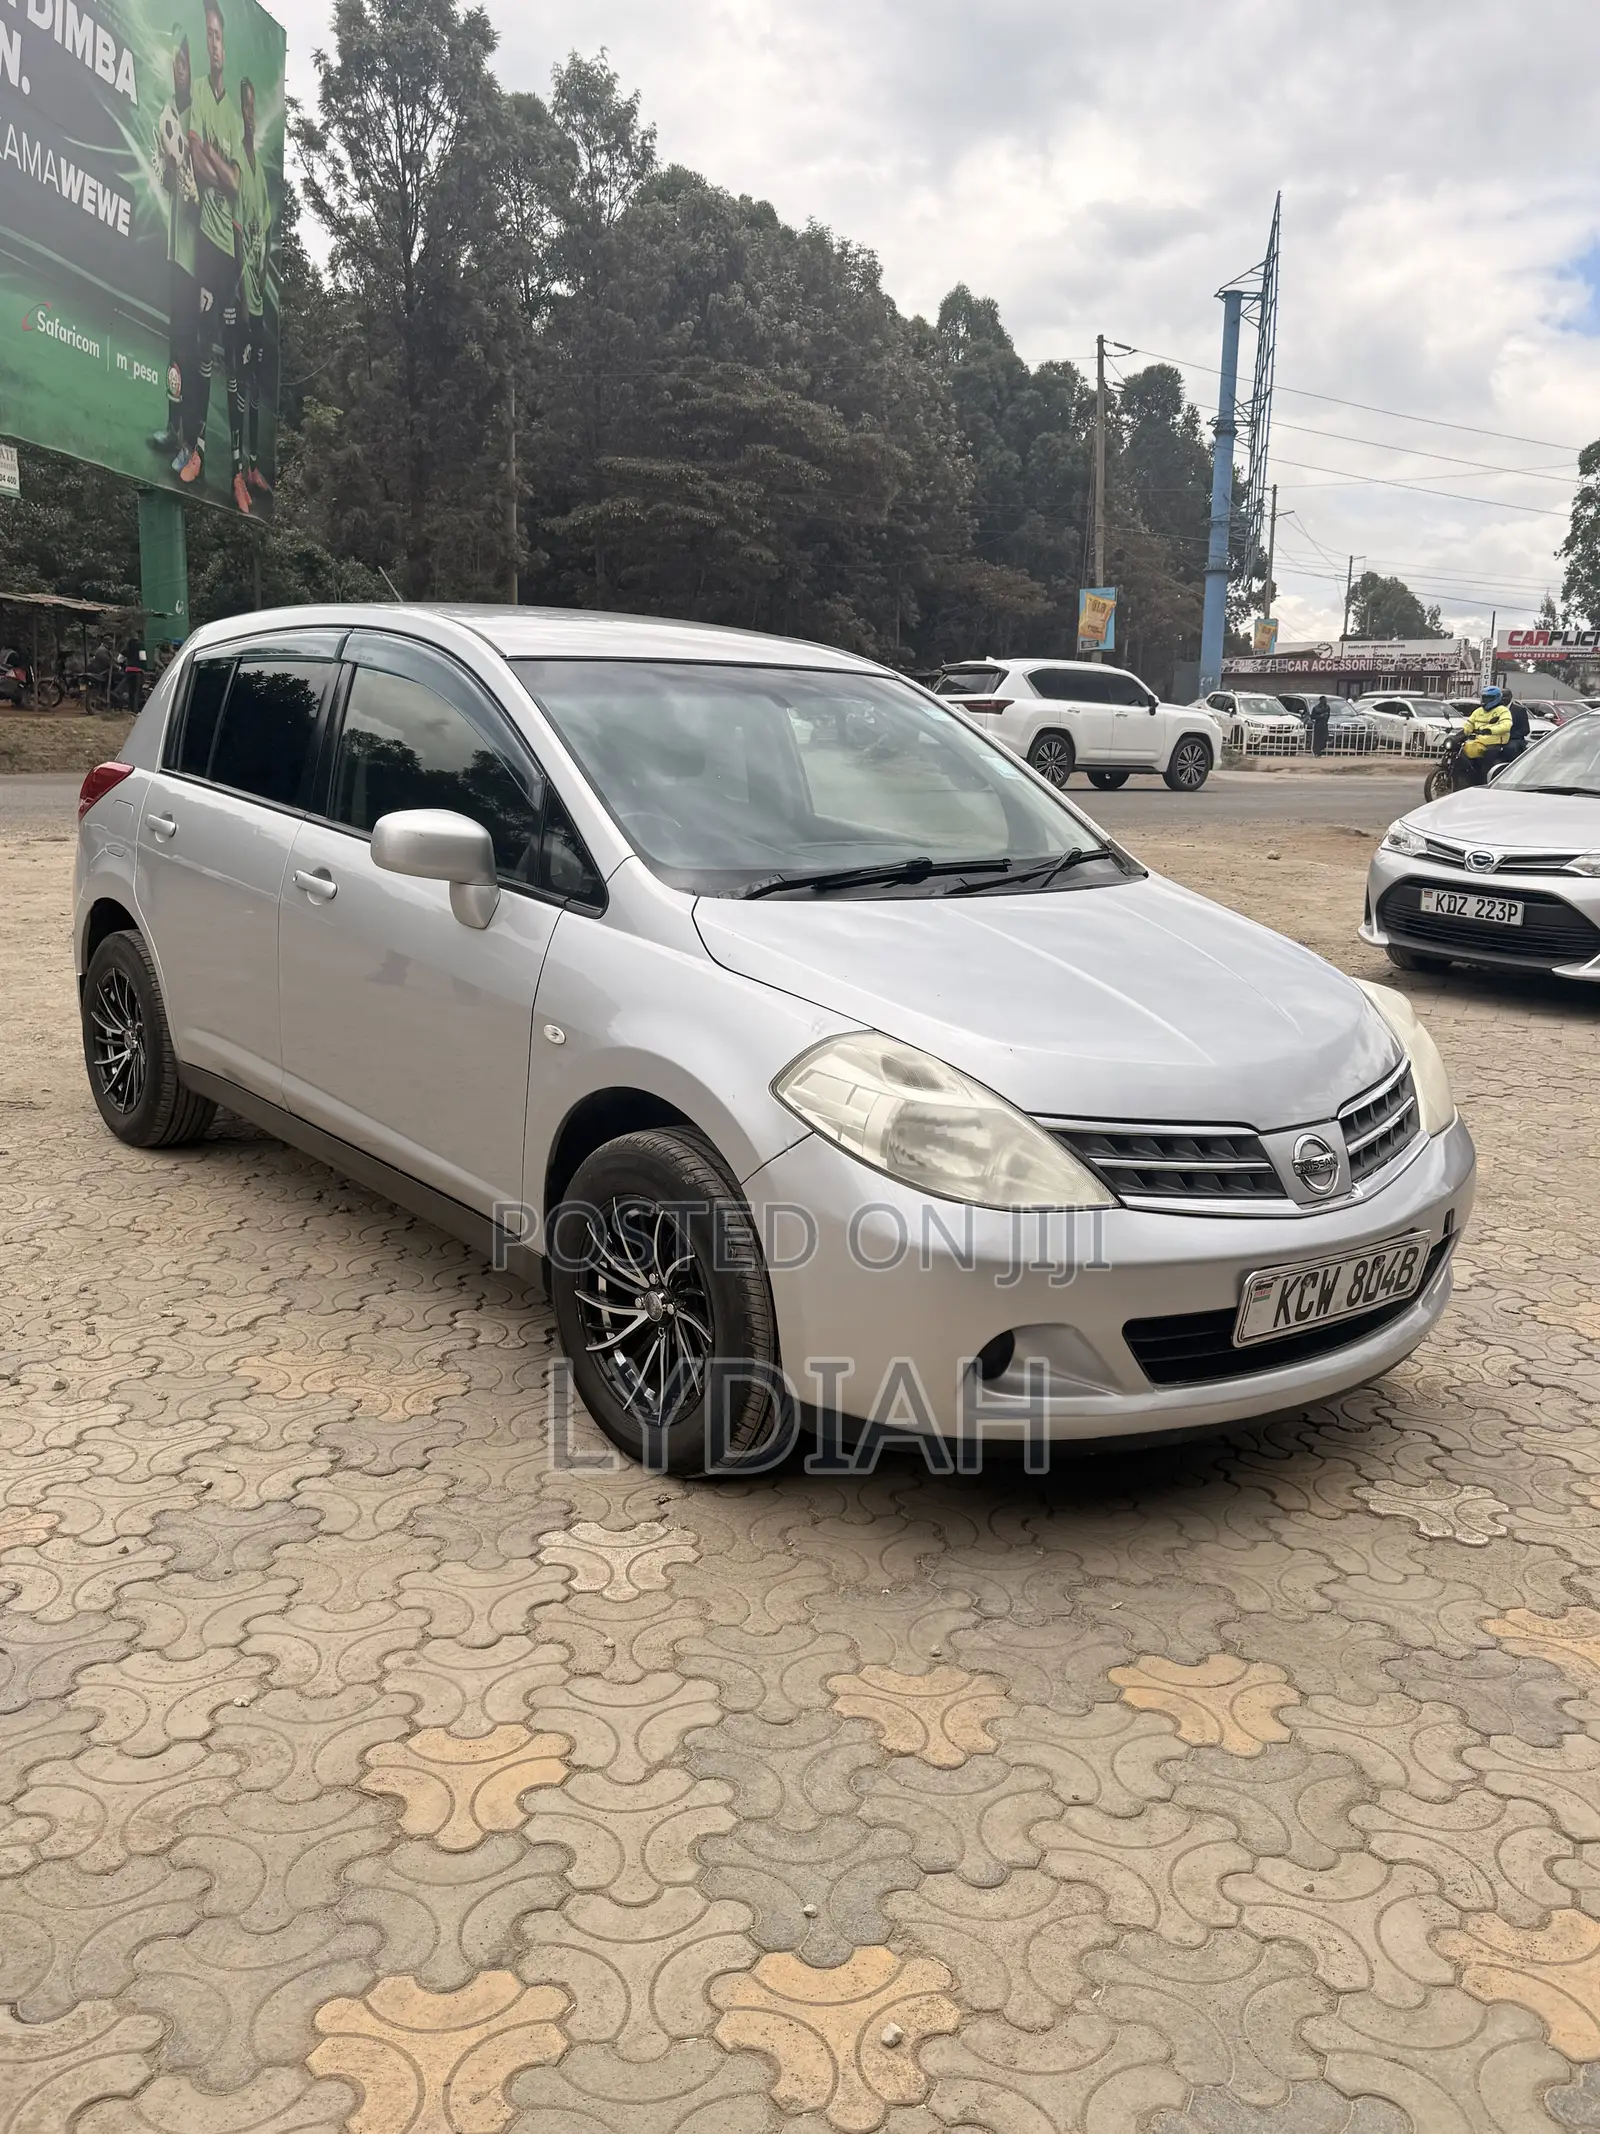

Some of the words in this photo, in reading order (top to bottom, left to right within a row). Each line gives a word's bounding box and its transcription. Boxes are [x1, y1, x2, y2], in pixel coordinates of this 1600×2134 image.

[27, 0, 138, 106] DIMBA
[0, 117, 131, 237] AMAWEWE
[37, 310, 100, 359] Safaricom
[1508, 630, 1600, 647] CARPLICI
[1287, 660, 1309, 672] CAR
[1483, 639, 1493, 688] CARPLICI
[1435, 892, 1469, 917] KDZ
[1474, 897, 1518, 923] 223P
[1300, 1155, 1338, 1173] NISSAN
[1273, 1265, 1343, 1328] KCW
[1346, 1246, 1420, 1305] 804B
